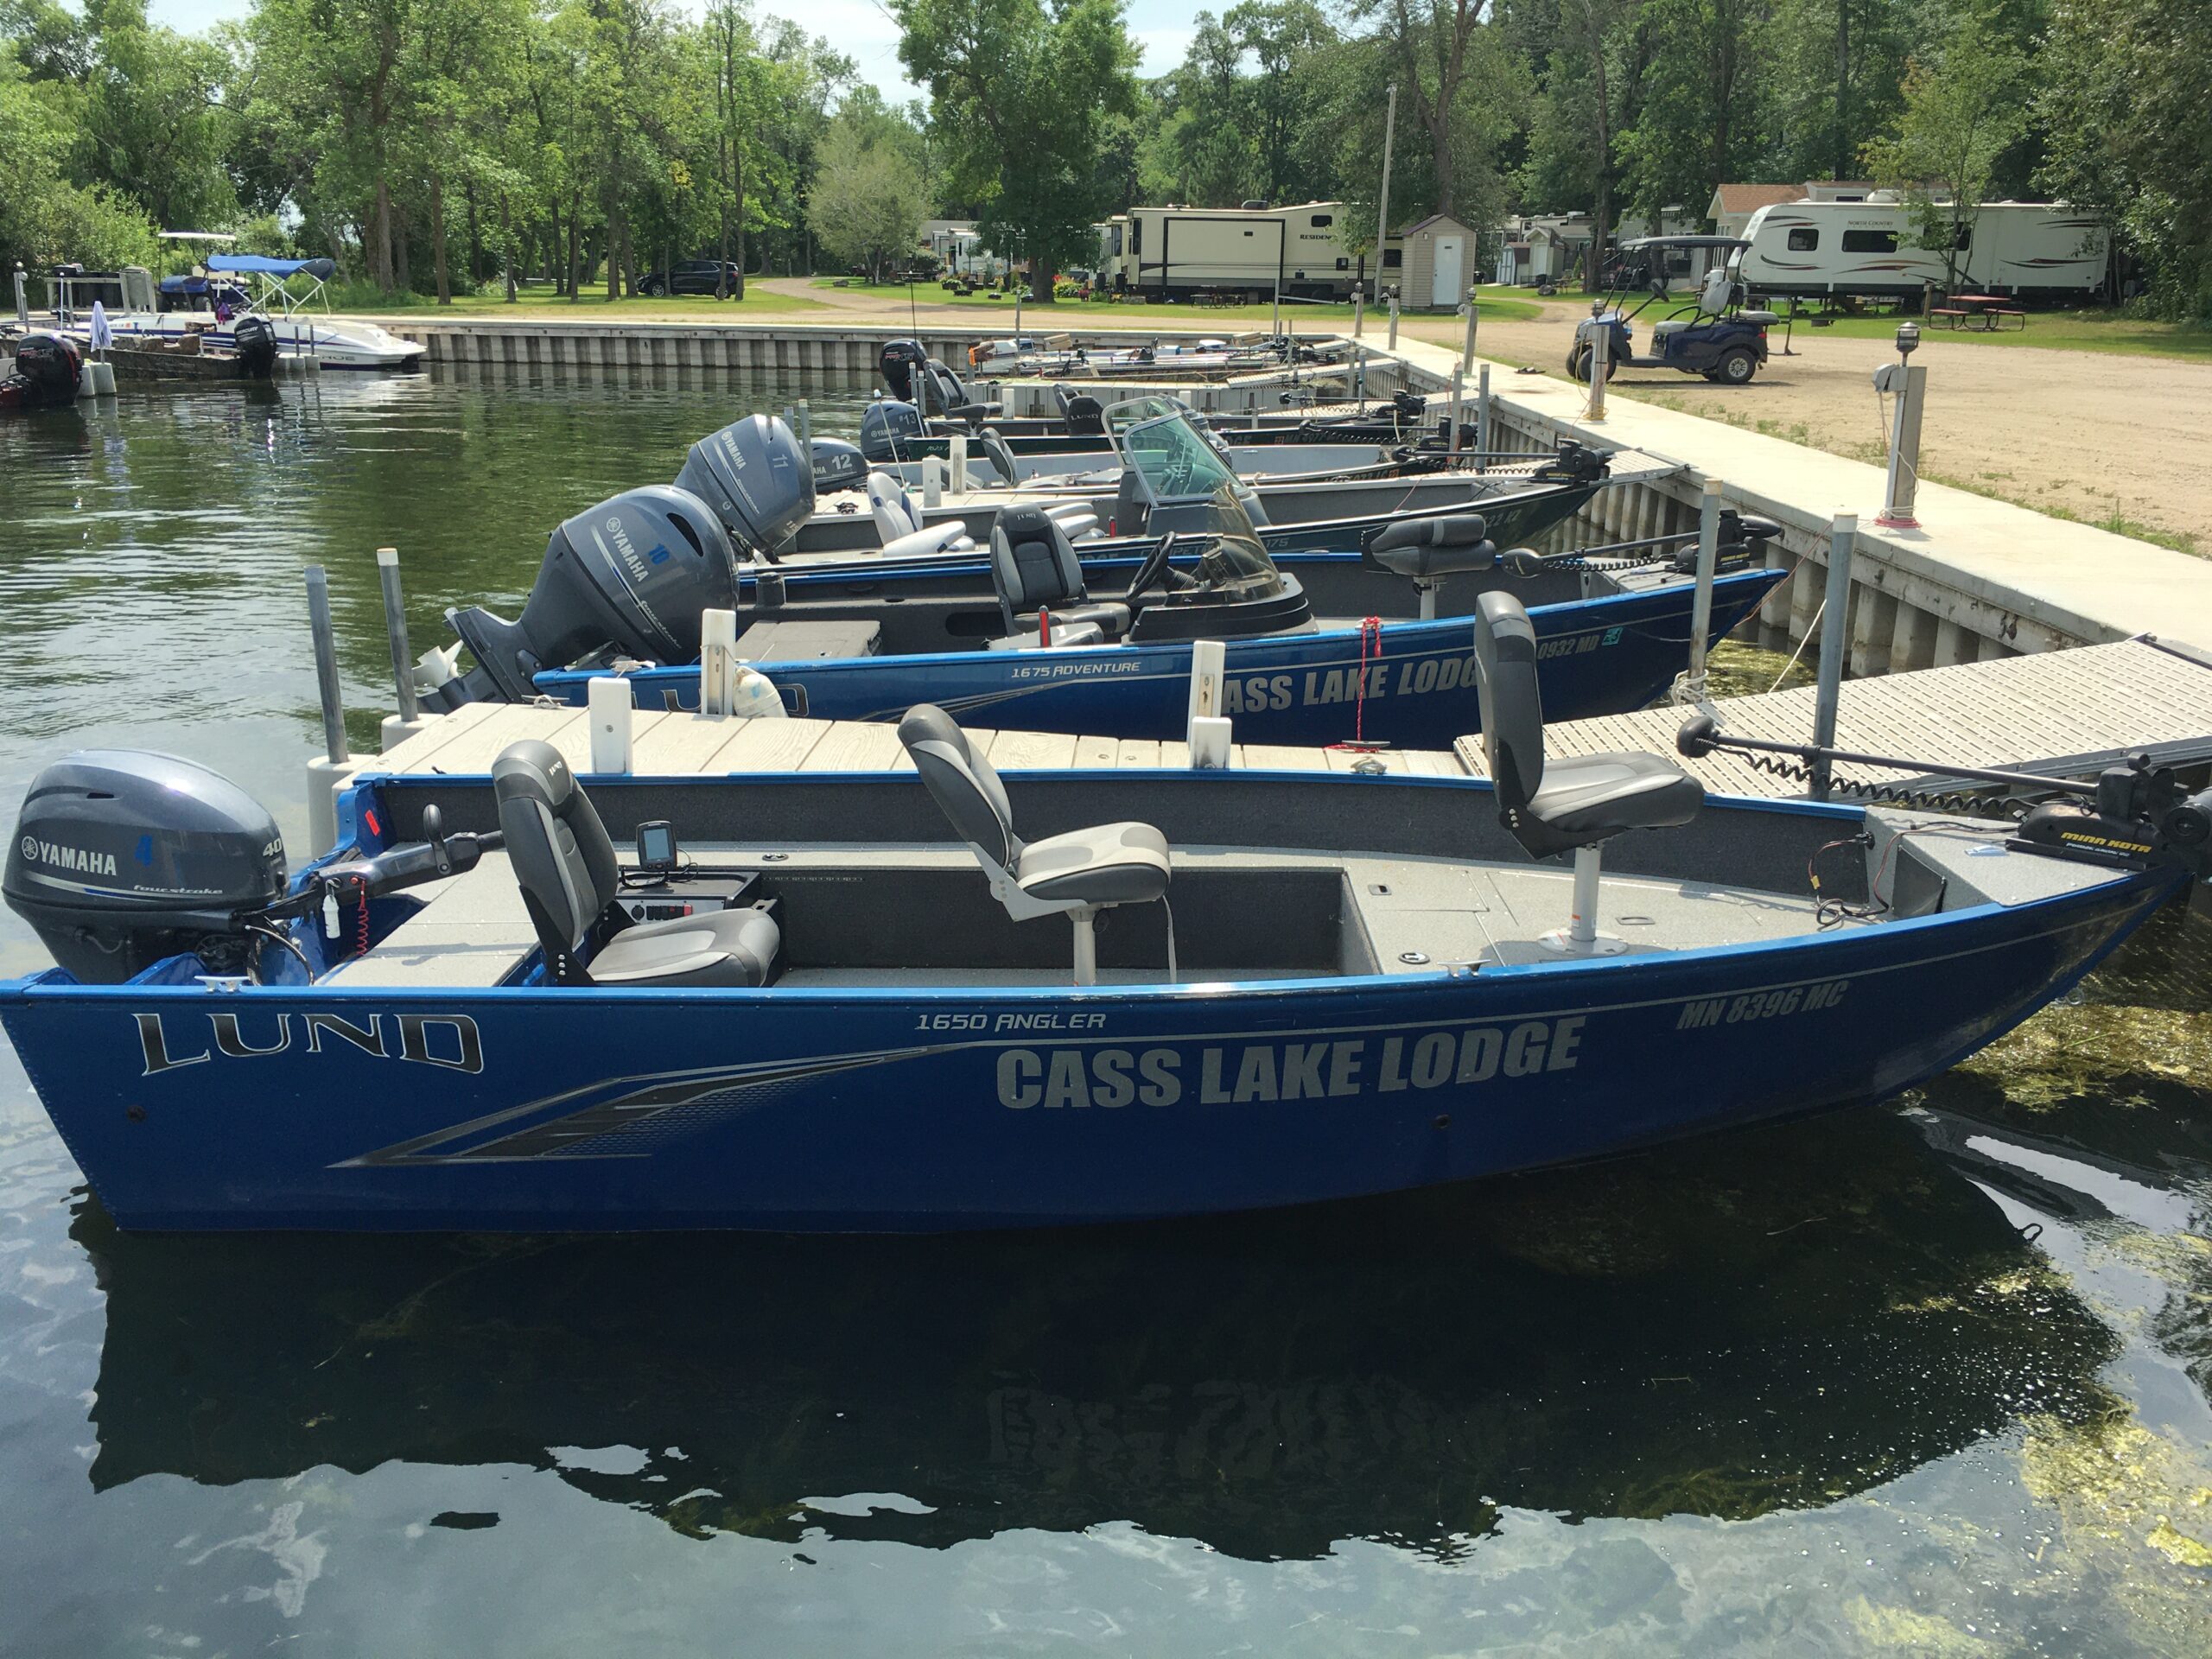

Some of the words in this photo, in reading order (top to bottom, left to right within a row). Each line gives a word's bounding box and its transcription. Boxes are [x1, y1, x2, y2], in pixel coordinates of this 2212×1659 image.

[725, 438, 747, 470] YAMAHA
[772, 454, 789, 468] 11
[832, 454, 853, 470] 12
[812, 466, 827, 474] AHA
[612, 529, 649, 582] YAMAHA
[649, 543, 670, 565] 10
[1538, 639, 1576, 659] 0932
[1011, 668, 1051, 678] 1675
[1052, 662, 1141, 677] ADVENTURE
[1220, 675, 1294, 714] ASS
[1303, 664, 1389, 706] LAKE
[1397, 655, 1477, 696] LODG
[134, 835, 154, 868] 4
[262, 837, 283, 857] 40
[2107, 840, 2152, 854] KOTA
[39, 841, 118, 876] YAMAHA
[1675, 999, 1727, 1030] MN
[1726, 988, 1803, 1024] 8396
[1801, 980, 1850, 1012] MC
[914, 1014, 988, 1030] 1650
[995, 1014, 1107, 1033] ANGLER
[131, 1013, 484, 1077] LUND
[996, 1048, 1181, 1109] CASS
[1200, 1040, 1363, 1104] LAKE
[1377, 1016, 1586, 1093] LODGE
